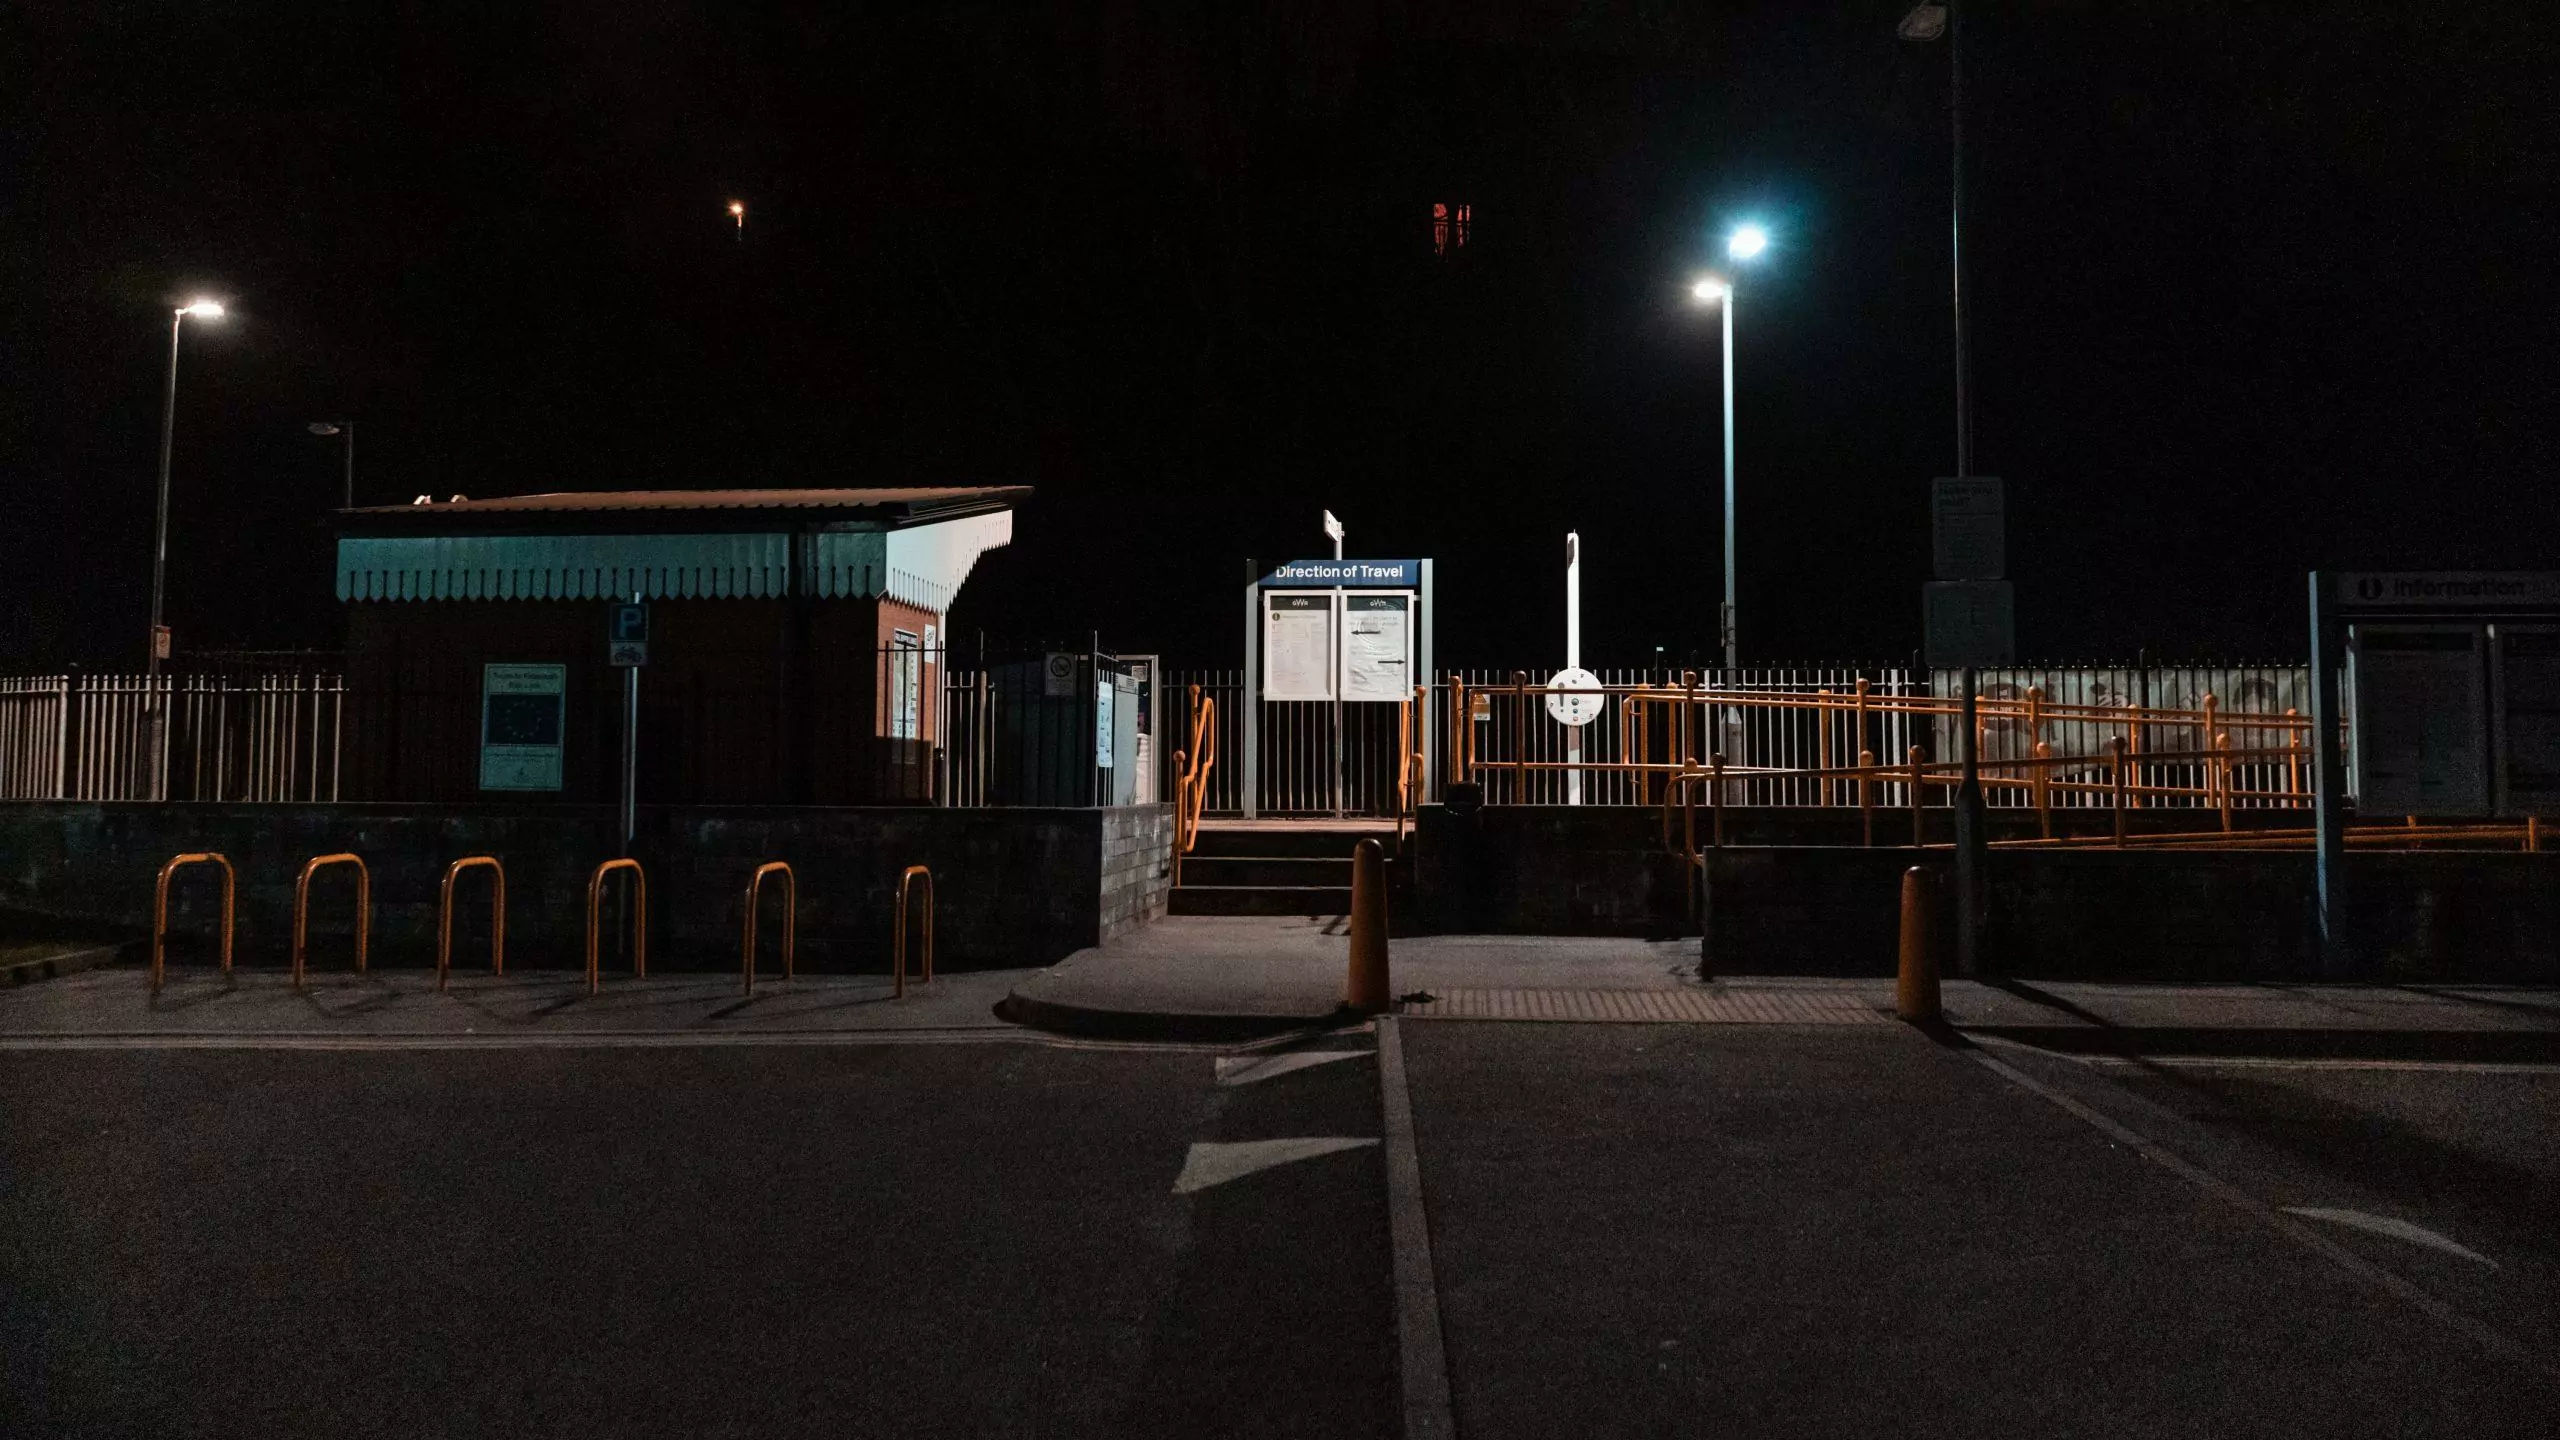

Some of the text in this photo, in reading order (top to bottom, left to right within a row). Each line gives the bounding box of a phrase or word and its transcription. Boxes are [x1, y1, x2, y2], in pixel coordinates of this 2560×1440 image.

[1276, 565, 1403, 578] Direction of Travel
[2394, 578, 2525, 597] Information
[619, 607, 642, 638] P
